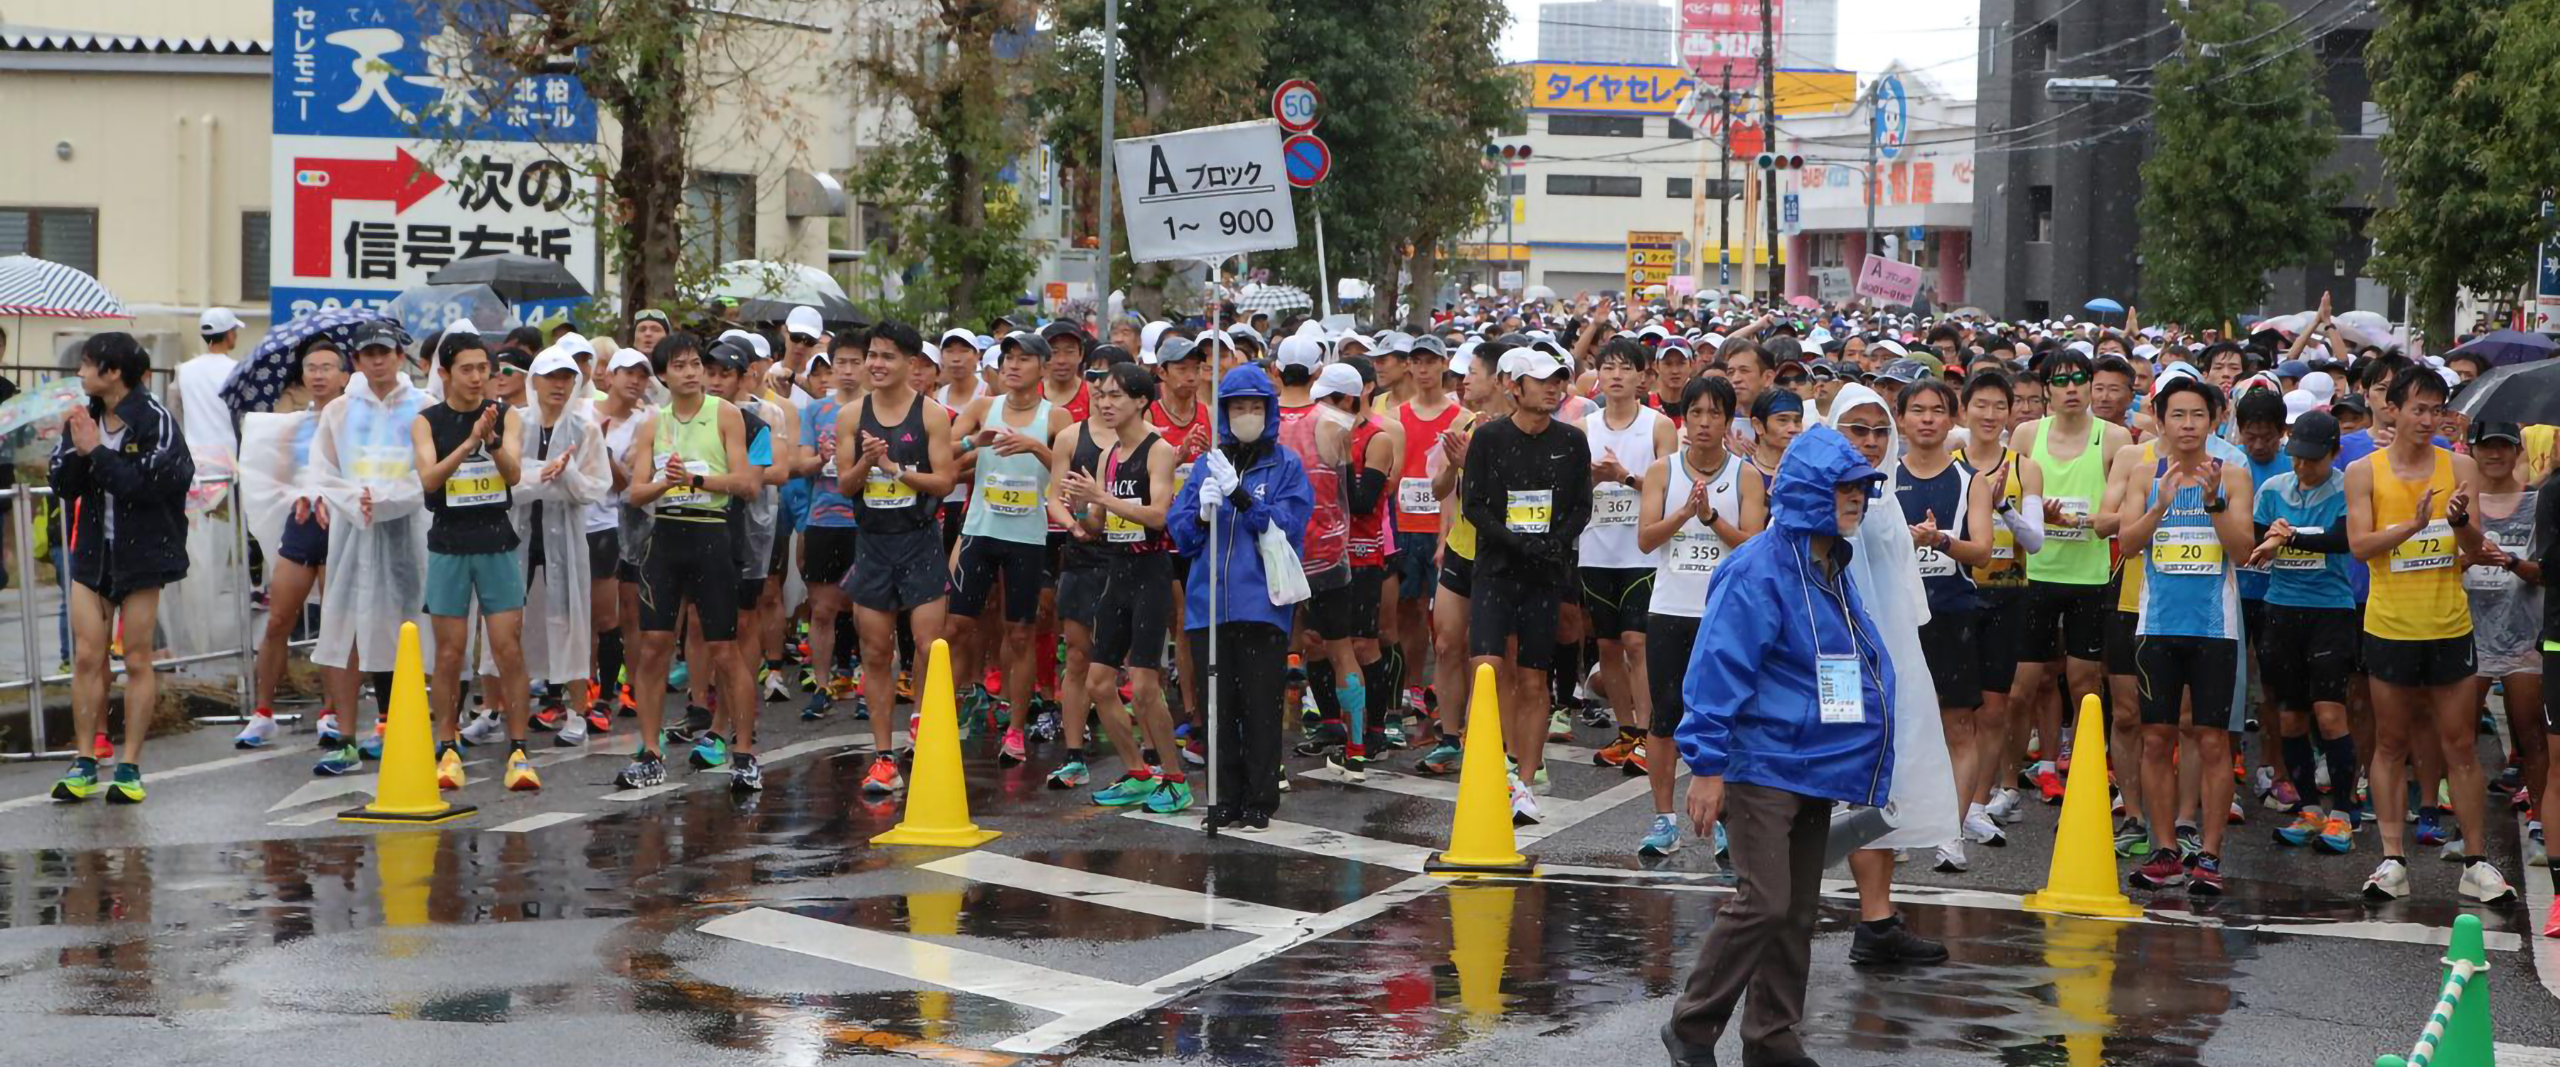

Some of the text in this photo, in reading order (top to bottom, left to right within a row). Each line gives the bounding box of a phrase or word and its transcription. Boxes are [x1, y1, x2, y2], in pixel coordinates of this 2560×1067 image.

[293, 6, 316, 122] セレモニー
[514, 77, 570, 104] 北柏
[1284, 94, 1314, 118] 50
[507, 105, 575, 128] ホール
[1147, 144, 1263, 196] A ブロック
[456, 154, 573, 213] 次の
[1219, 207, 1275, 236] 900
[1871, 260, 1883, 279] A
[472, 477, 490, 492] 10
[887, 482, 896, 495] 4
[1002, 490, 1019, 503] 42
[1593, 499, 1633, 514] A 367
[1528, 506, 1546, 520] 15
[1671, 545, 1721, 561] A 359
[2180, 544, 2203, 560] 20
[2392, 538, 2442, 558] A 72
[1820, 674, 1836, 706] STAFF
